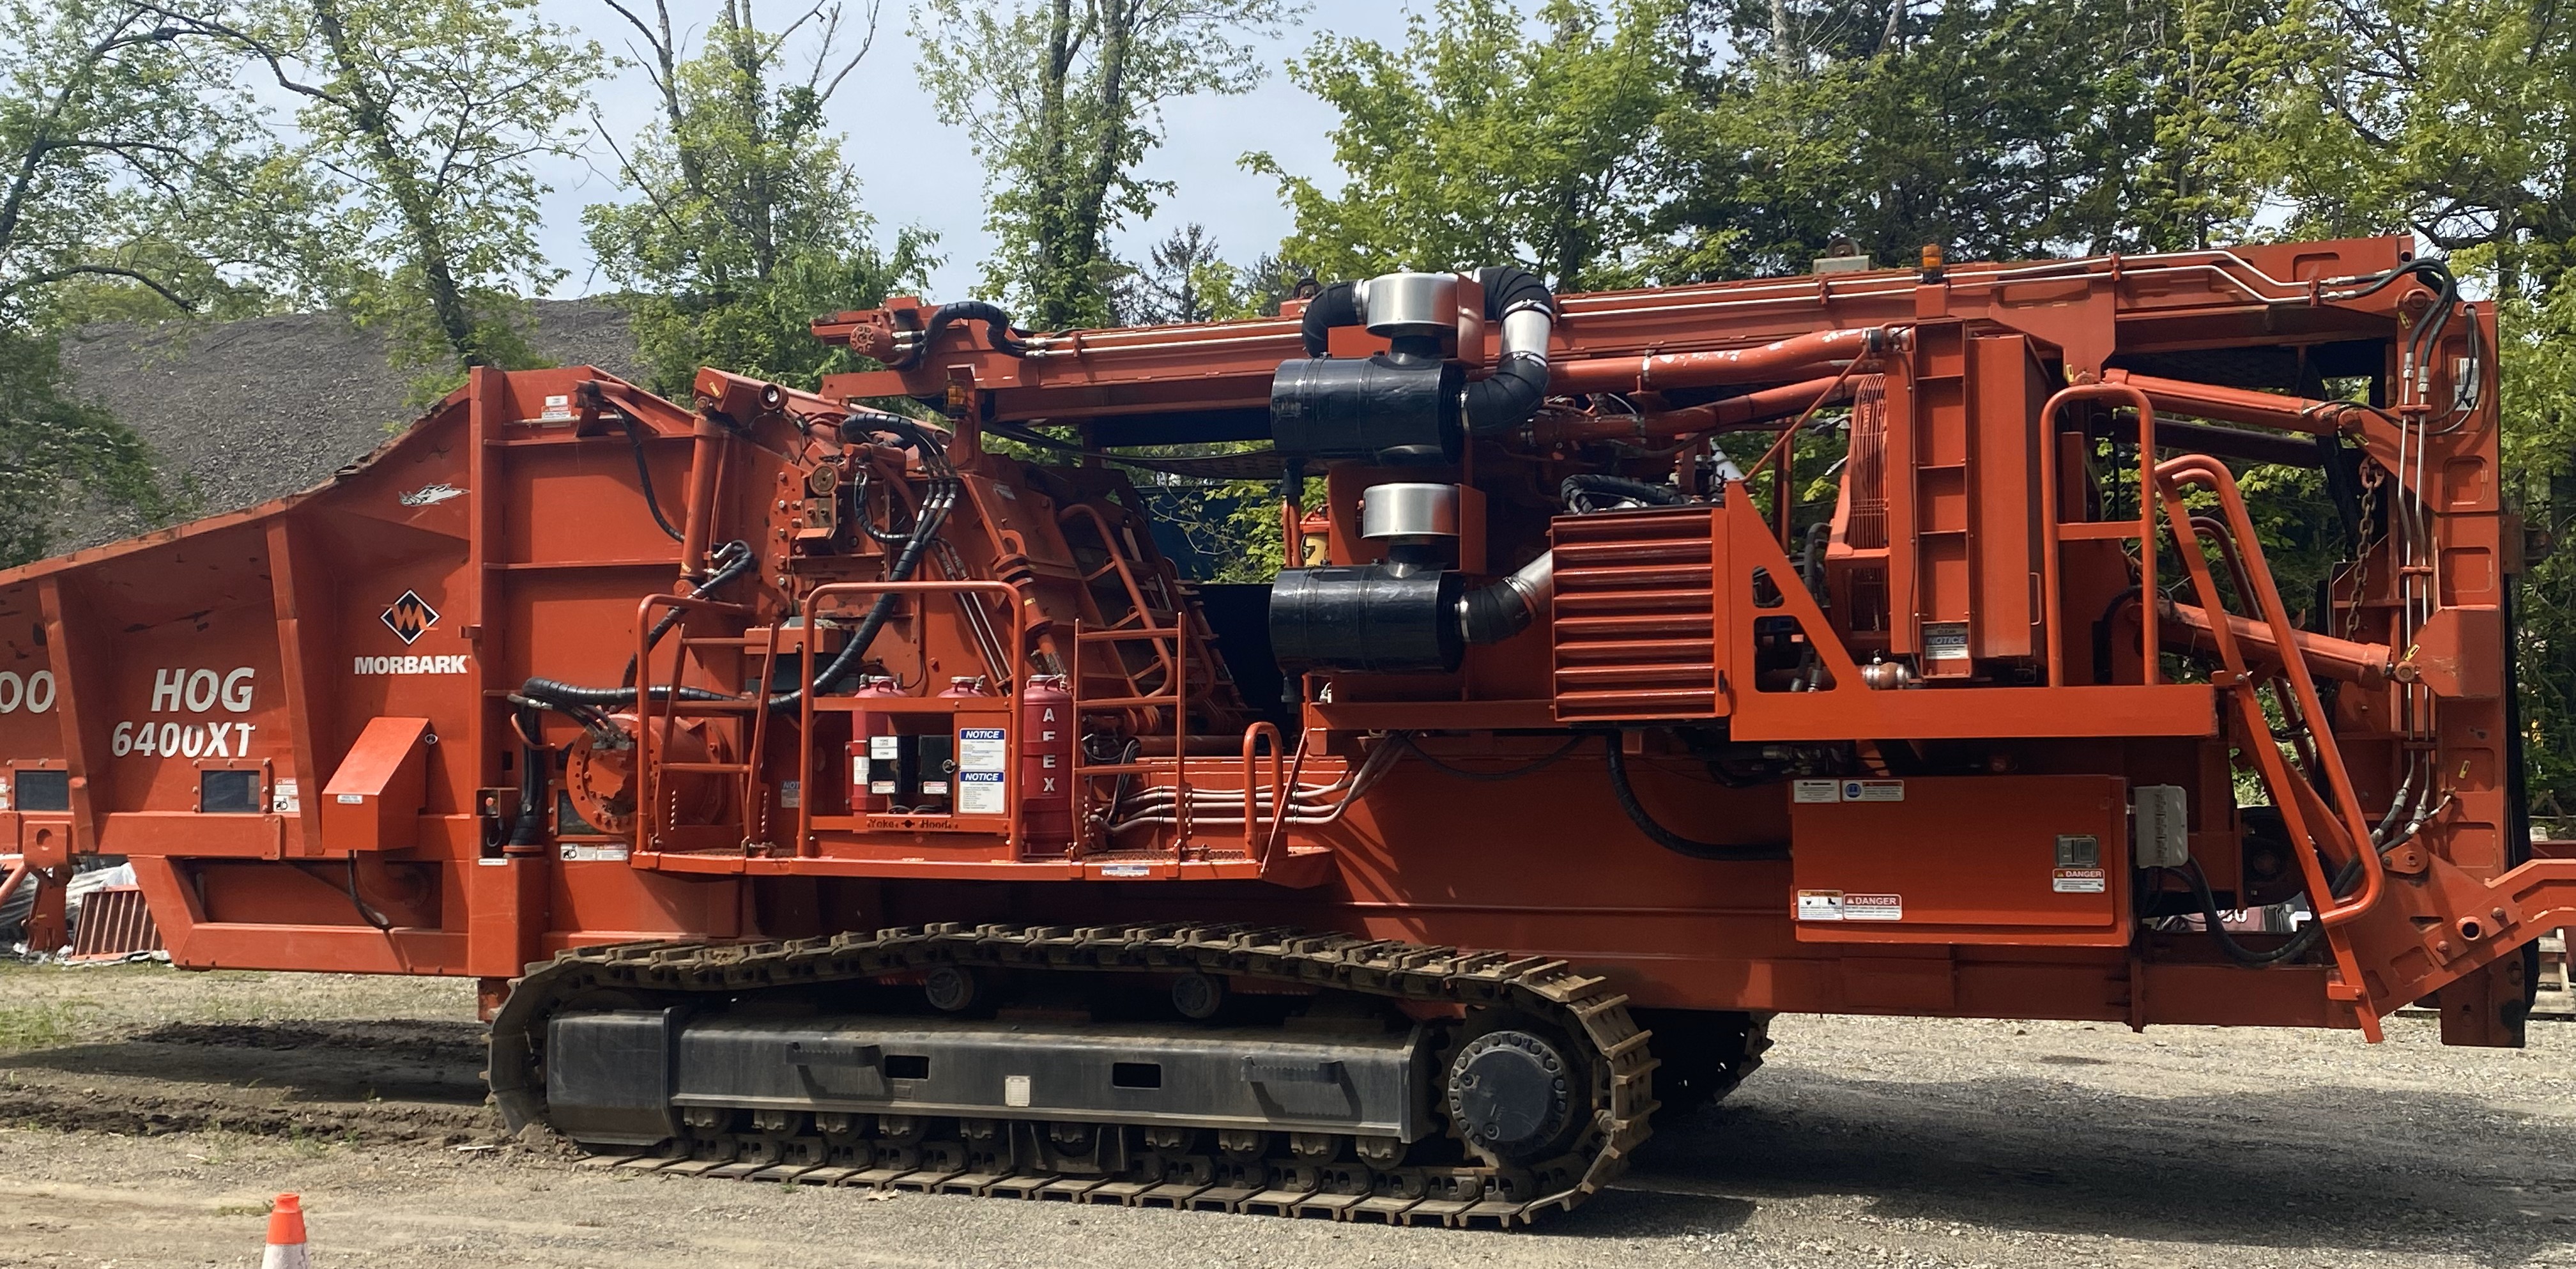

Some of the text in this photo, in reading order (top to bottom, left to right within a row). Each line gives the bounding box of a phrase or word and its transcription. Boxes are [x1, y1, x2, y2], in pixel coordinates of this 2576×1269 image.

[1928, 636, 1966, 645] NOTICE
[354, 655, 469, 675] MORBARK
[0, 667, 256, 714] OO HOG
[111, 721, 256, 758] 6400XT
[965, 730, 1000, 739] NOTICE
[965, 773, 999, 781] NOTICE
